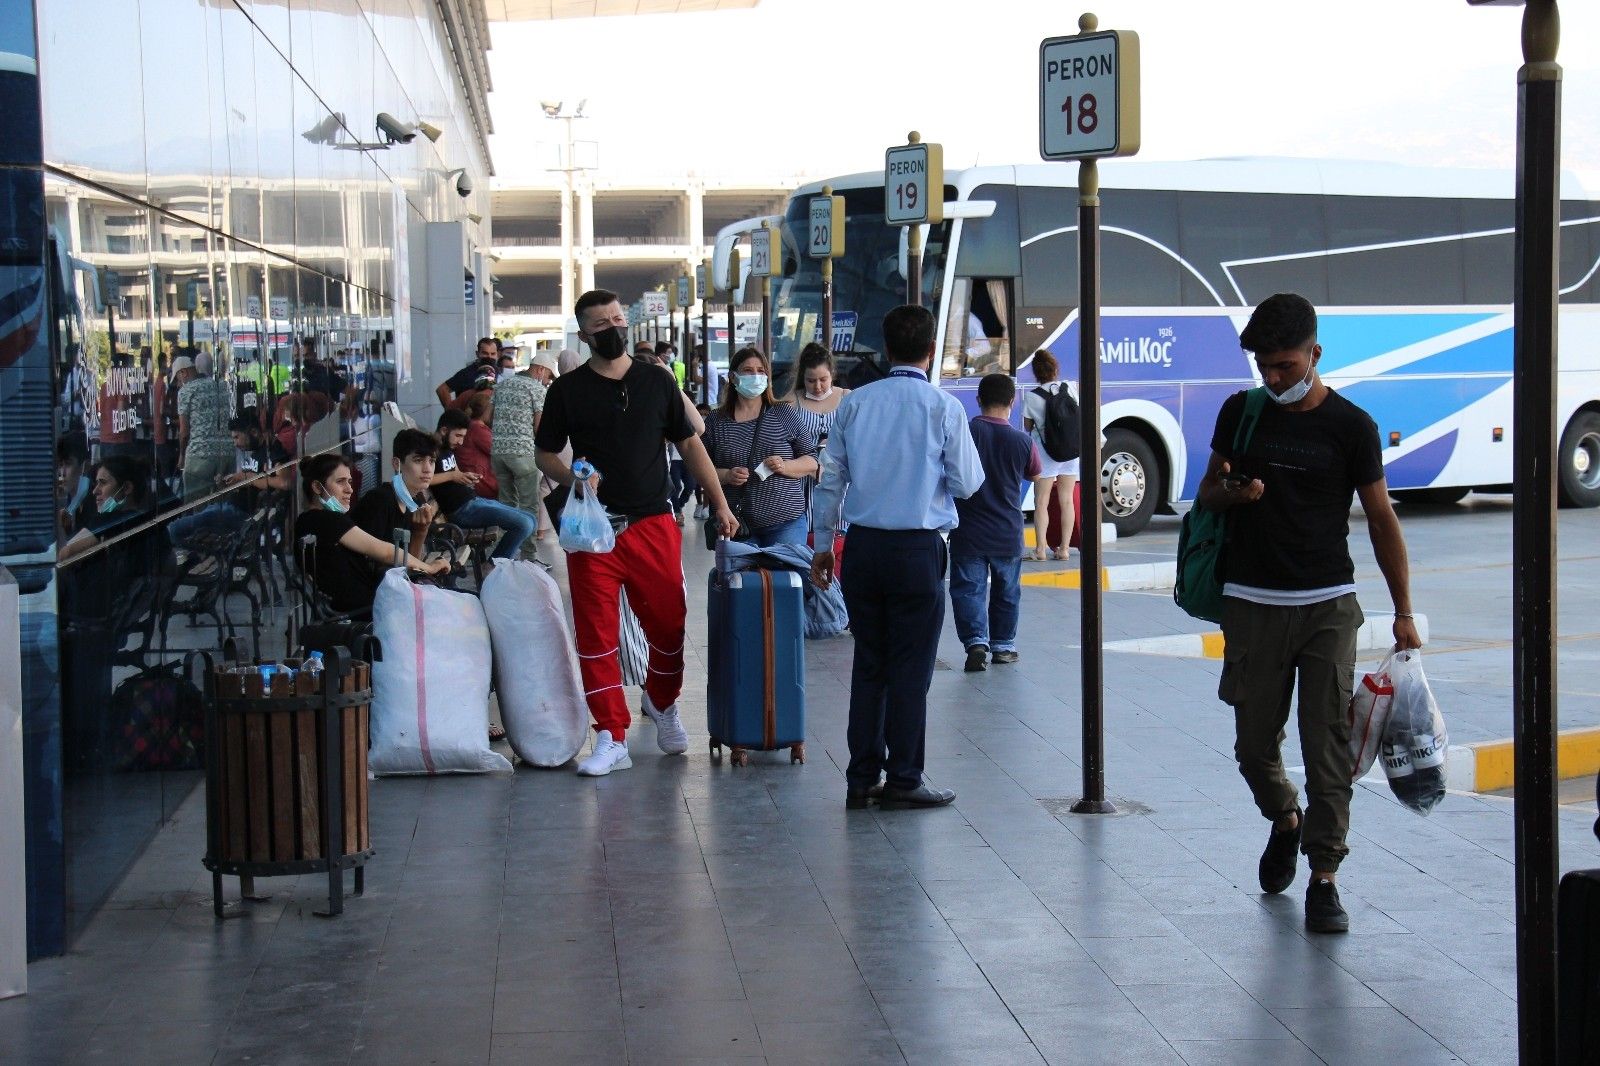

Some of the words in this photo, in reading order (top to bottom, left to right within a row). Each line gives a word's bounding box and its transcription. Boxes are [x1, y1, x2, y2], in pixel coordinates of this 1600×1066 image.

[1047, 53, 1112, 82] PERON
[1061, 93, 1098, 135] 18
[890, 160, 924, 175] PERON
[896, 182, 918, 210] 19
[812, 208, 831, 219] PERON
[813, 225, 828, 246] 20
[756, 251, 767, 267] 21
[649, 303, 664, 312] 26
[1158, 327, 1173, 337] 1926
